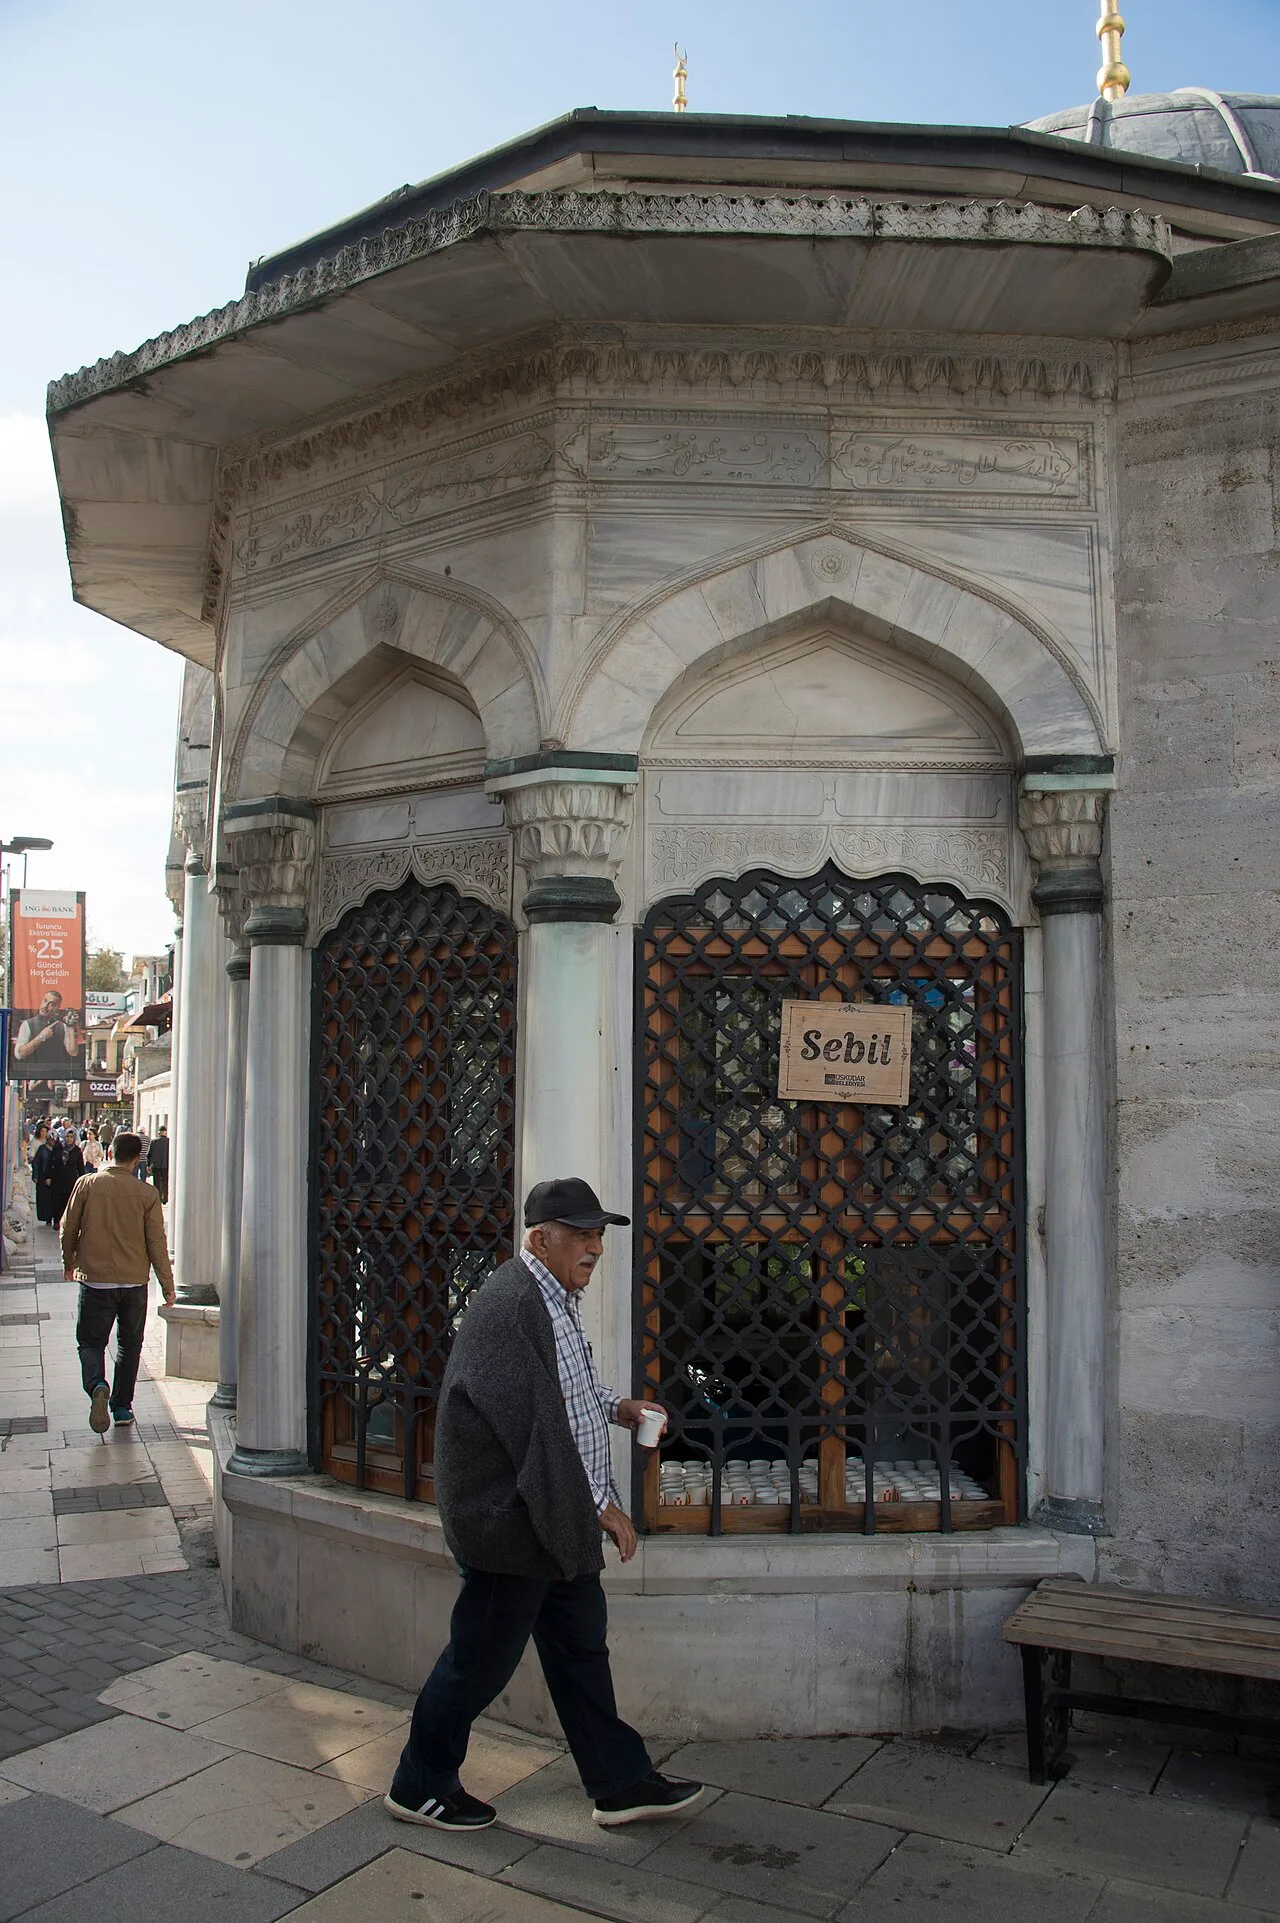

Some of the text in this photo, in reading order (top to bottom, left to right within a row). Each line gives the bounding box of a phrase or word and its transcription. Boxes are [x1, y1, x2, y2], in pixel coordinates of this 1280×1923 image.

[25, 904, 74, 913] ING BANK
[35, 922, 62, 930] Turuncu
[28, 938, 64, 959] %25
[36, 961, 63, 969] Güncel
[30, 969, 70, 978] Hoş Geldin
[800, 1029, 891, 1066] Sebil
